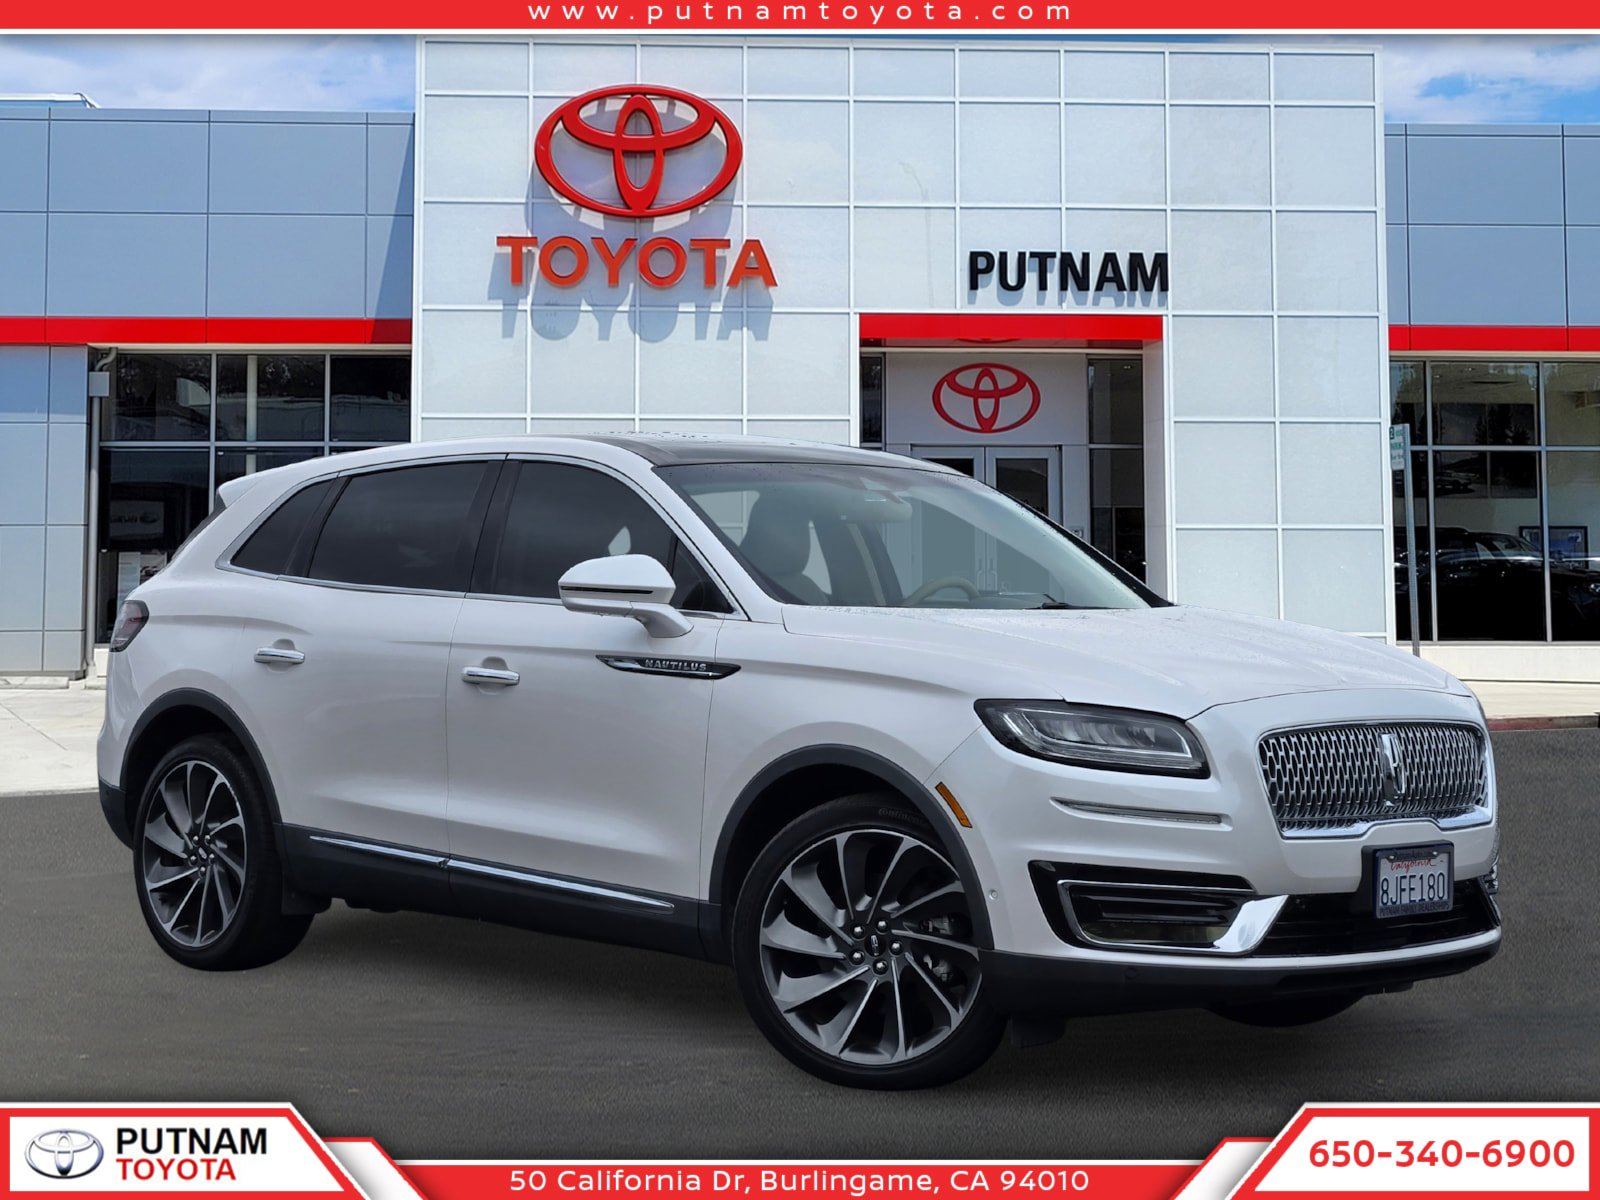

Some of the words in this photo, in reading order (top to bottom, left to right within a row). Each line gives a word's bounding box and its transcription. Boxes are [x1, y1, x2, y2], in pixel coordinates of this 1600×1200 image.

[496, 235, 778, 288] TOYOTA
[969, 250, 1169, 292] PUTNAM
[644, 659, 707, 671] NAUTILUS
[1381, 872, 1445, 906] 8JFE180
